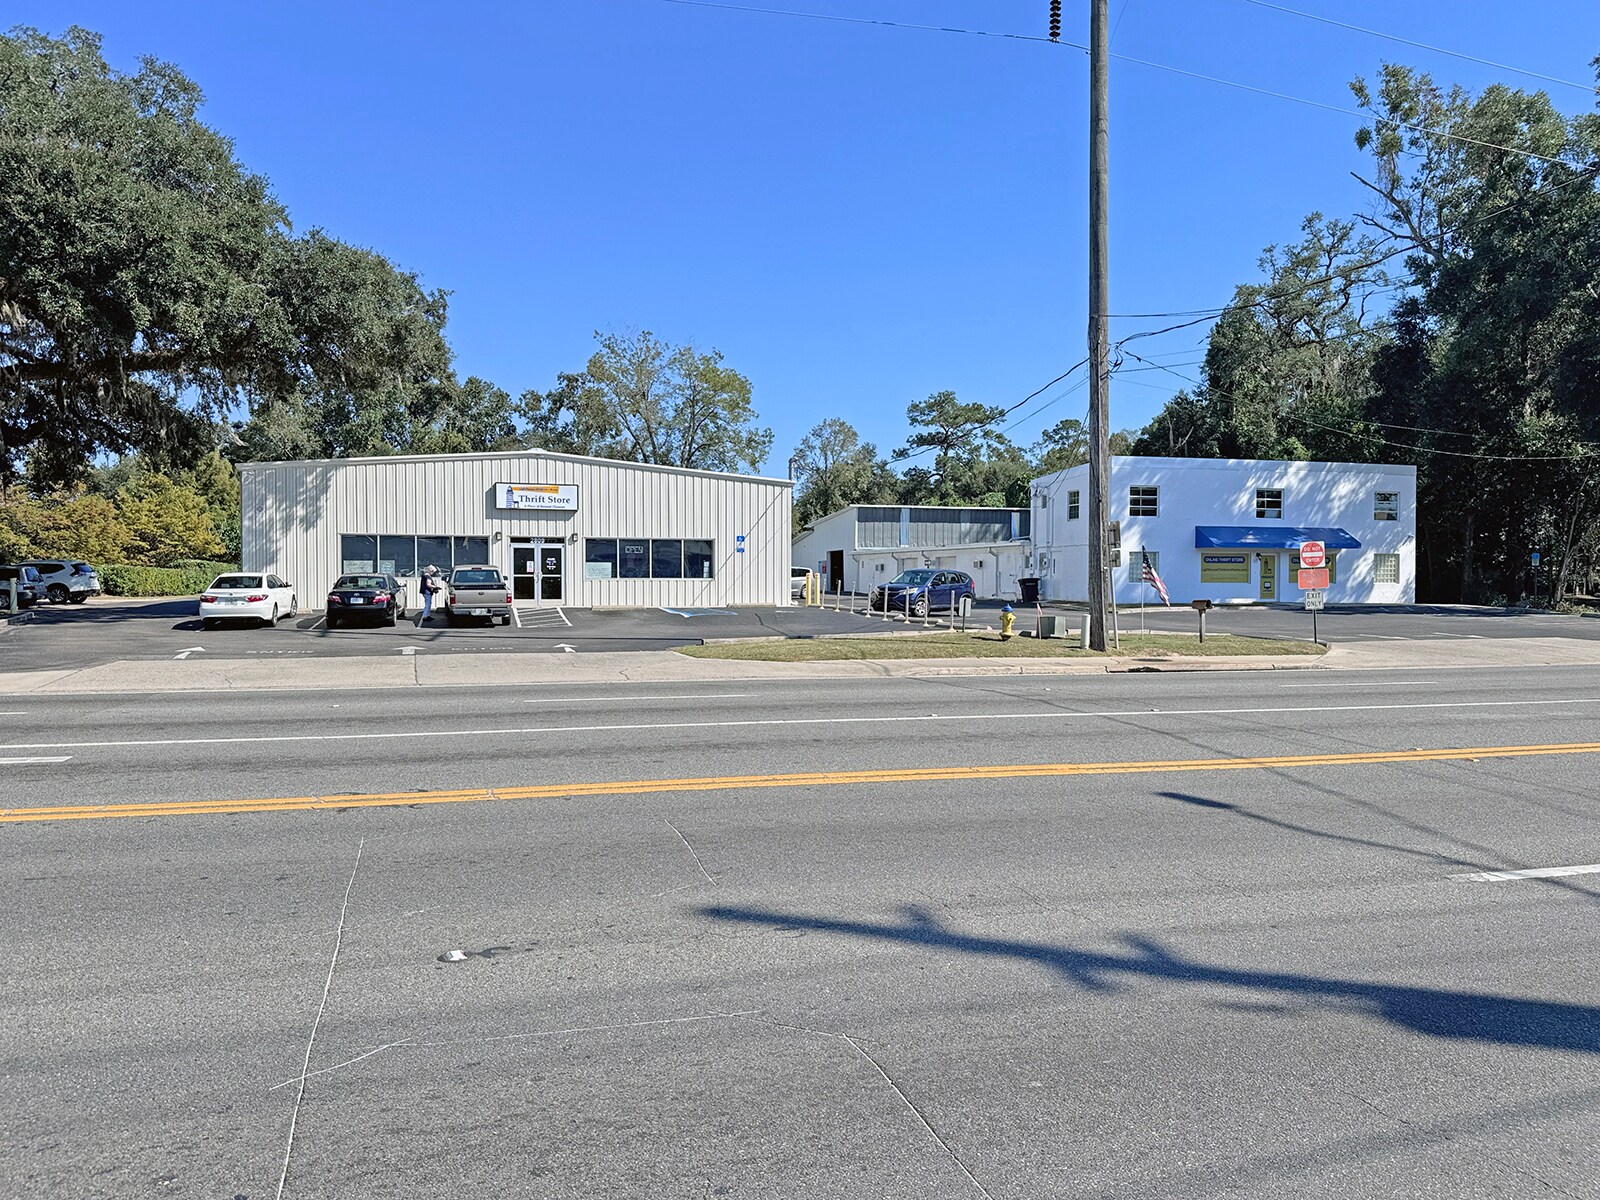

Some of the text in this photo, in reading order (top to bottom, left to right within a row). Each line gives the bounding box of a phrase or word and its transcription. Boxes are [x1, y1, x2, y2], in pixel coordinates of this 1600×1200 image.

[518, 495, 571, 504] Thrift Store
[625, 545, 643, 553] OPEN
